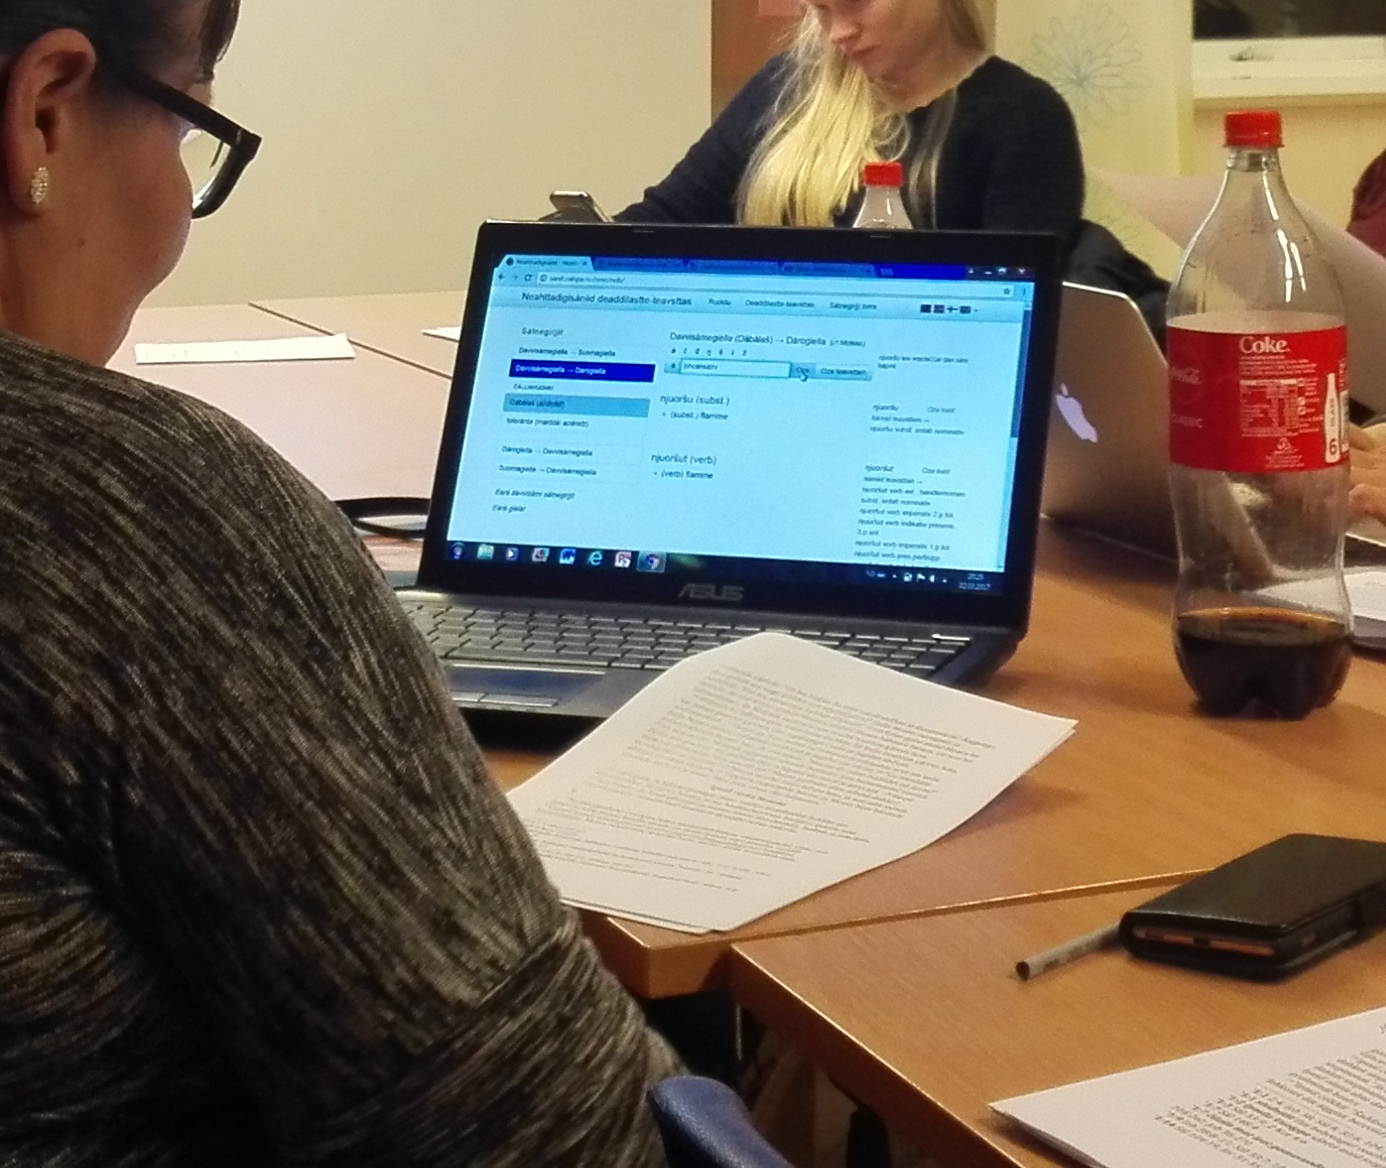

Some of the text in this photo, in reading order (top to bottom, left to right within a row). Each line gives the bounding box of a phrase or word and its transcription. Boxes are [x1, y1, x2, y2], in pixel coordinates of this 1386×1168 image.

[1239, 335, 1288, 354] Coke
[1328, 438, 1339, 456] 6
[678, 583, 744, 602] ASUS
